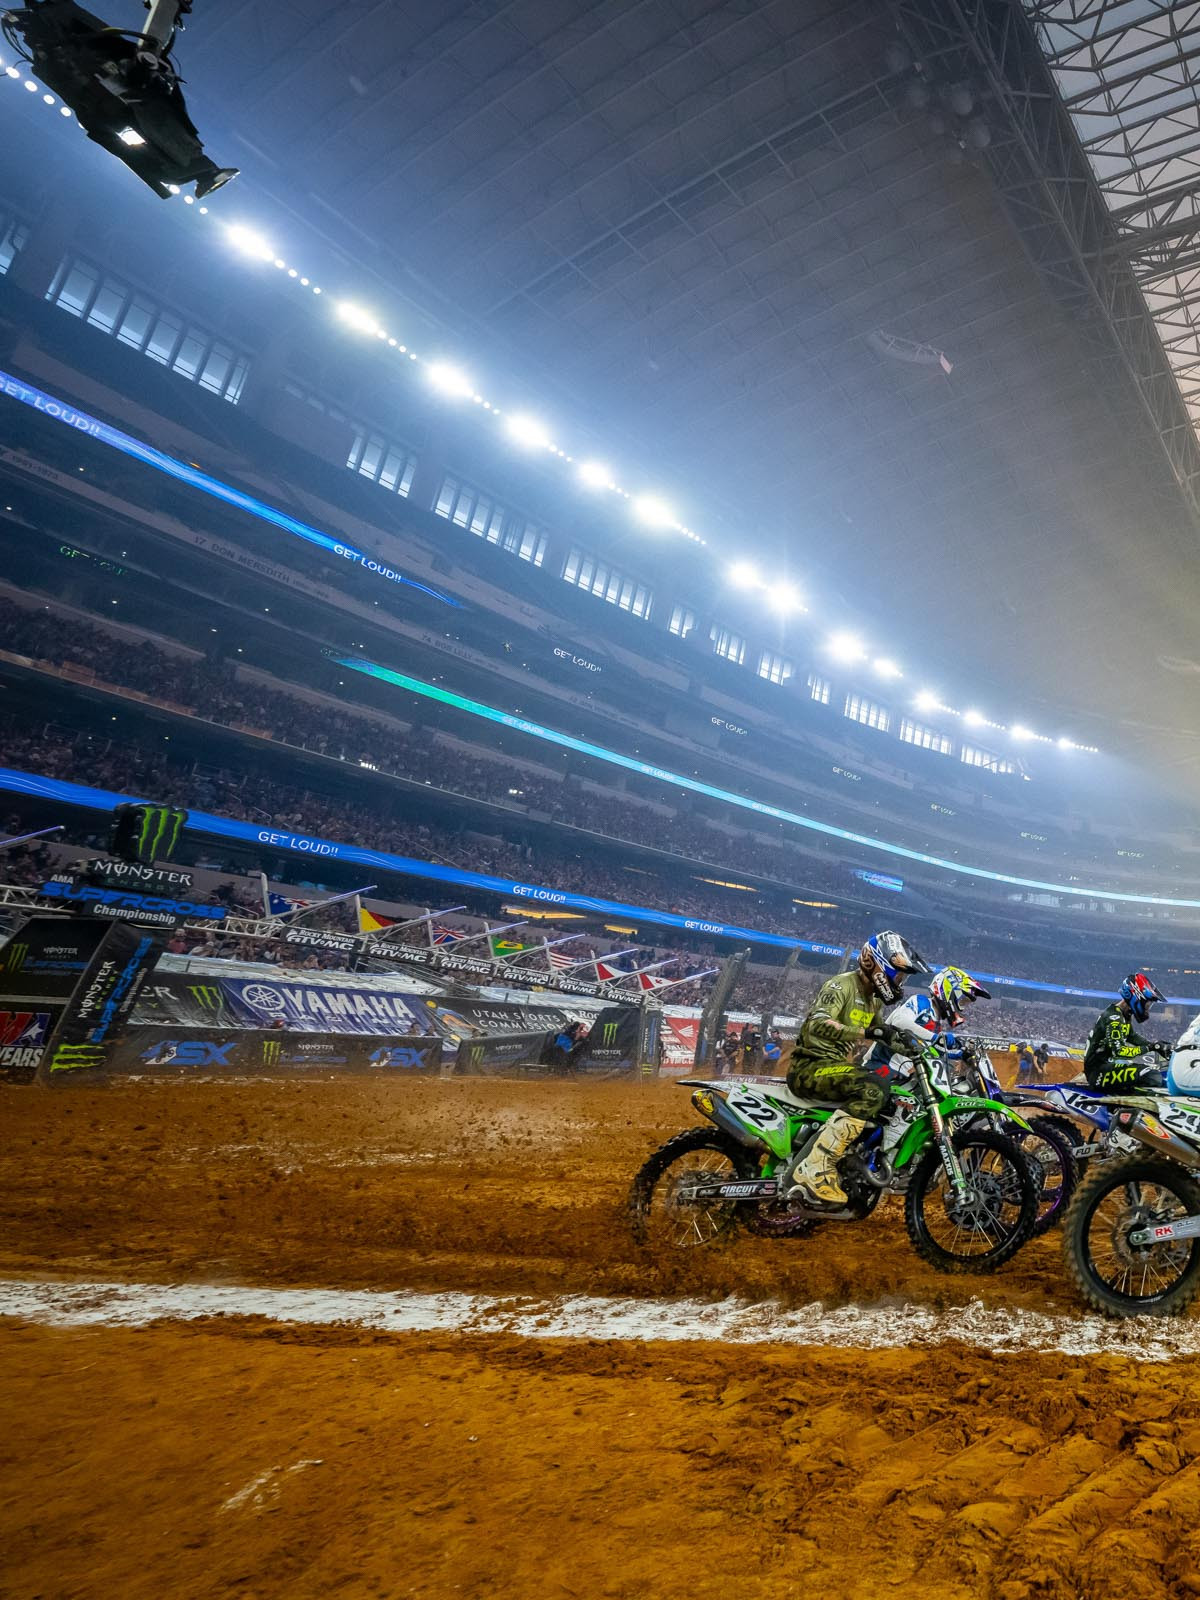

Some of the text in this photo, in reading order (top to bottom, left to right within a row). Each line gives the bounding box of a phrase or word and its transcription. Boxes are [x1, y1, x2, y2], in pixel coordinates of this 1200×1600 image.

[34, 397, 100, 437] LOUD!!
[333, 545, 401, 583] GET LOUD!!
[258, 831, 339, 857] GET LOUD!!
[51, 873, 74, 884] AMA
[94, 860, 192, 886] MONSTER
[38, 882, 226, 920] SUPERCROSS
[512, 884, 567, 904] GET LOUD!!
[93, 904, 177, 925] Championship
[684, 920, 700, 930] GET
[300, 930, 356, 944] ROCKY MOUNTAIN
[812, 944, 823, 952] GET
[282, 986, 416, 1018] YAMAHA
[472, 1009, 509, 1020] UTAH
[814, 1066, 855, 1076] CIRCUIT
[932, 1060, 948, 1086] 2
[1102, 1068, 1137, 1088] FXR
[731, 1096, 778, 1128] 22
[939, 1144, 954, 1176] MAXXIS
[1076, 1146, 1092, 1156] FLO
[720, 1185, 758, 1194] CIRCUIT
[1155, 1226, 1172, 1237] RK
